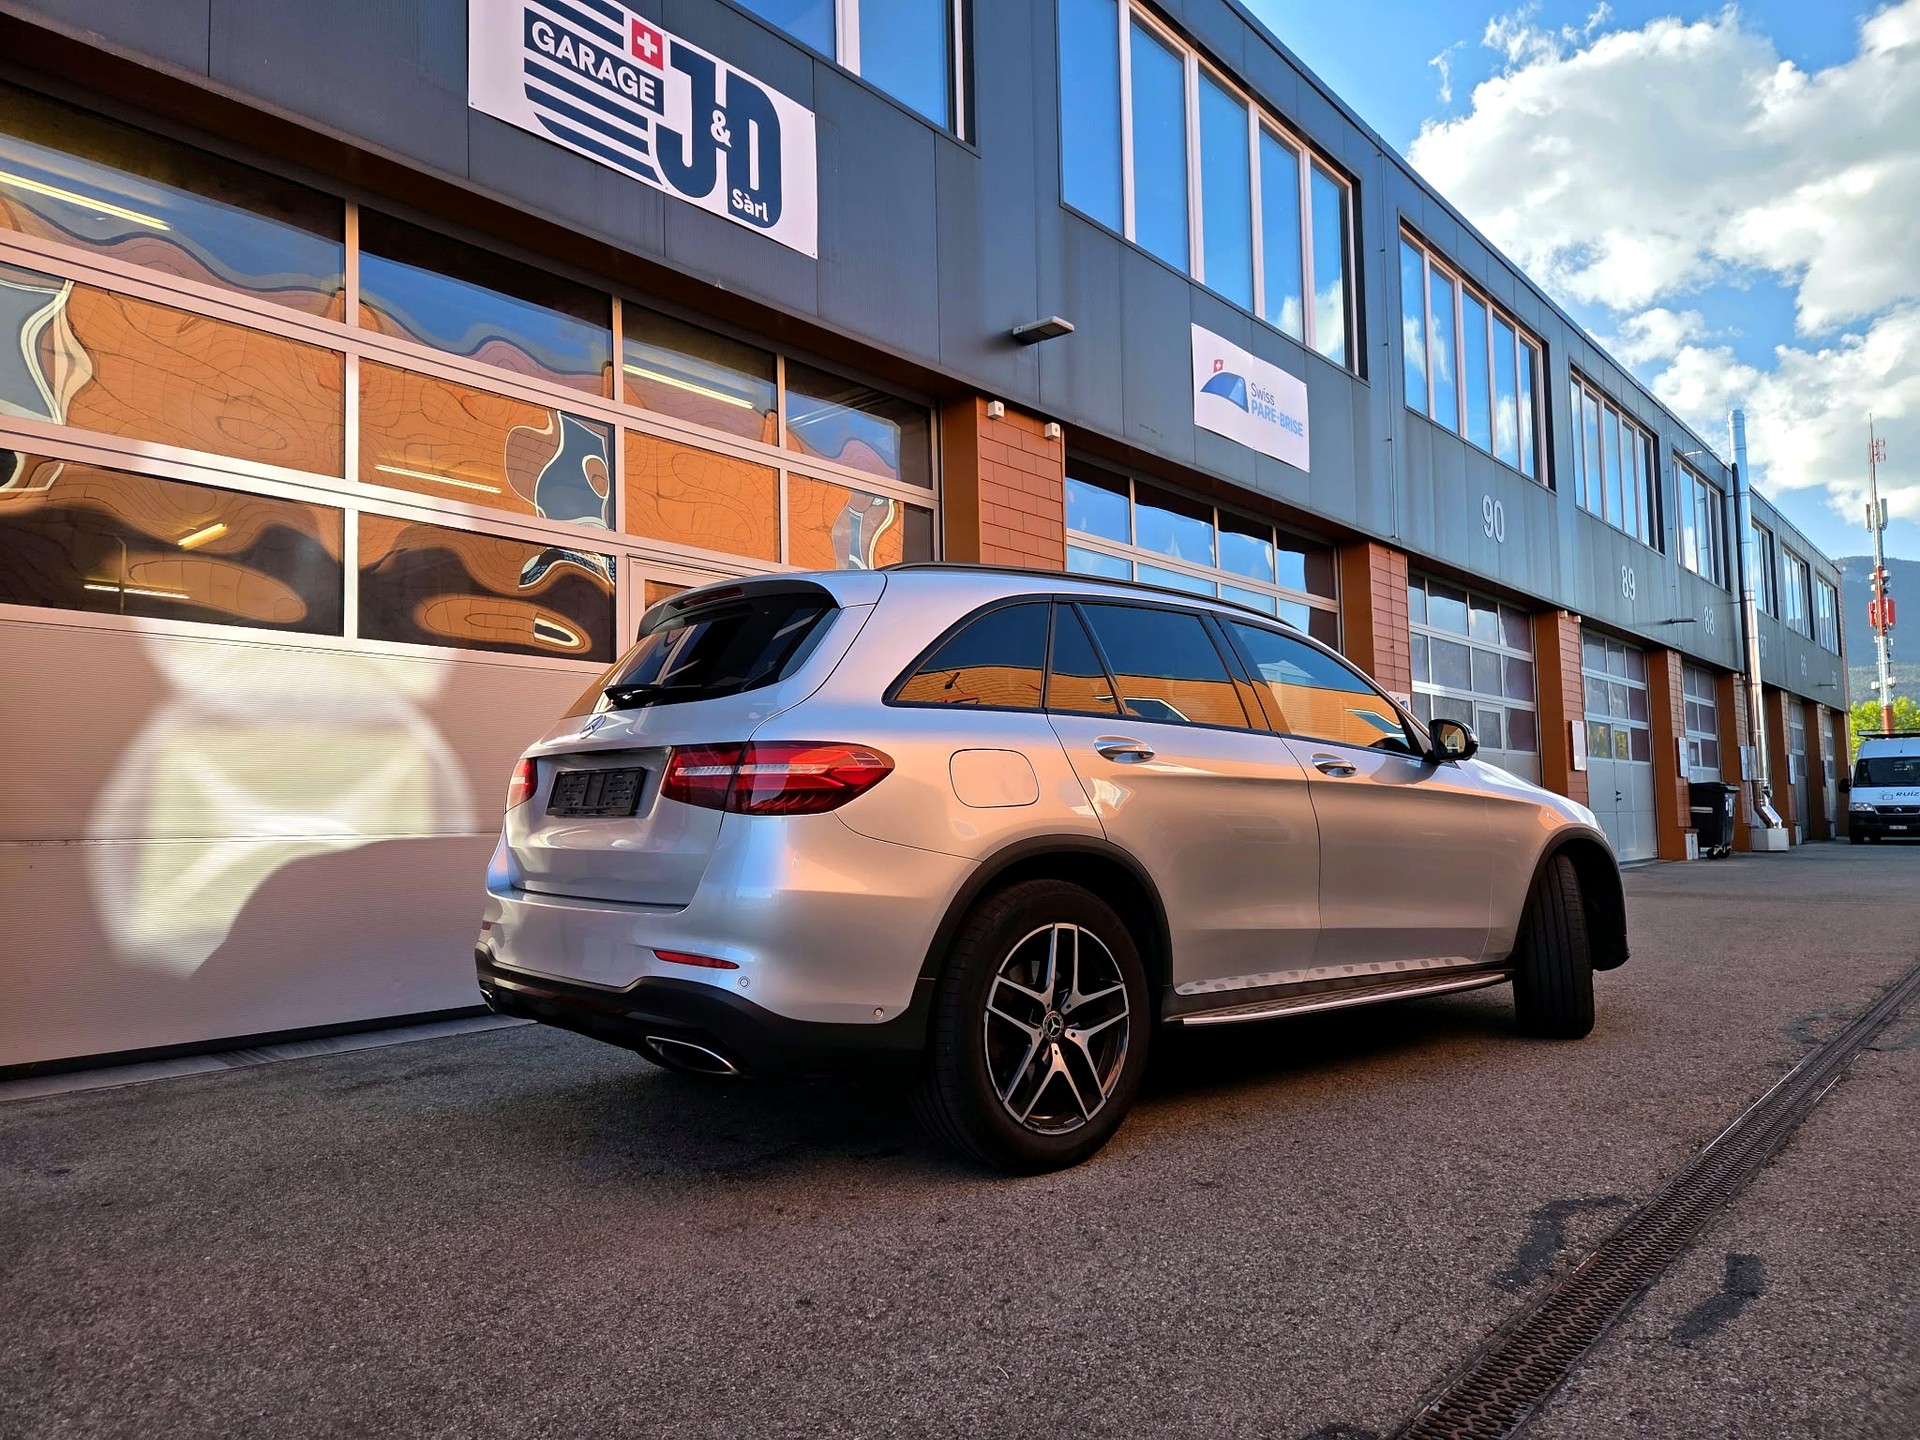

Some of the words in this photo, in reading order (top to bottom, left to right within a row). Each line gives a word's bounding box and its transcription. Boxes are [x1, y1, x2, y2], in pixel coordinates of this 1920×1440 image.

[531, 20, 656, 107] GARAGE
[731, 188, 769, 223] Sàrl
[1250, 382, 1275, 405] Swiss
[1251, 399, 1304, 437] PARE-BRISE
[1482, 494, 1505, 544] 90
[1621, 564, 1636, 601] 89
[1703, 606, 1715, 636] 88
